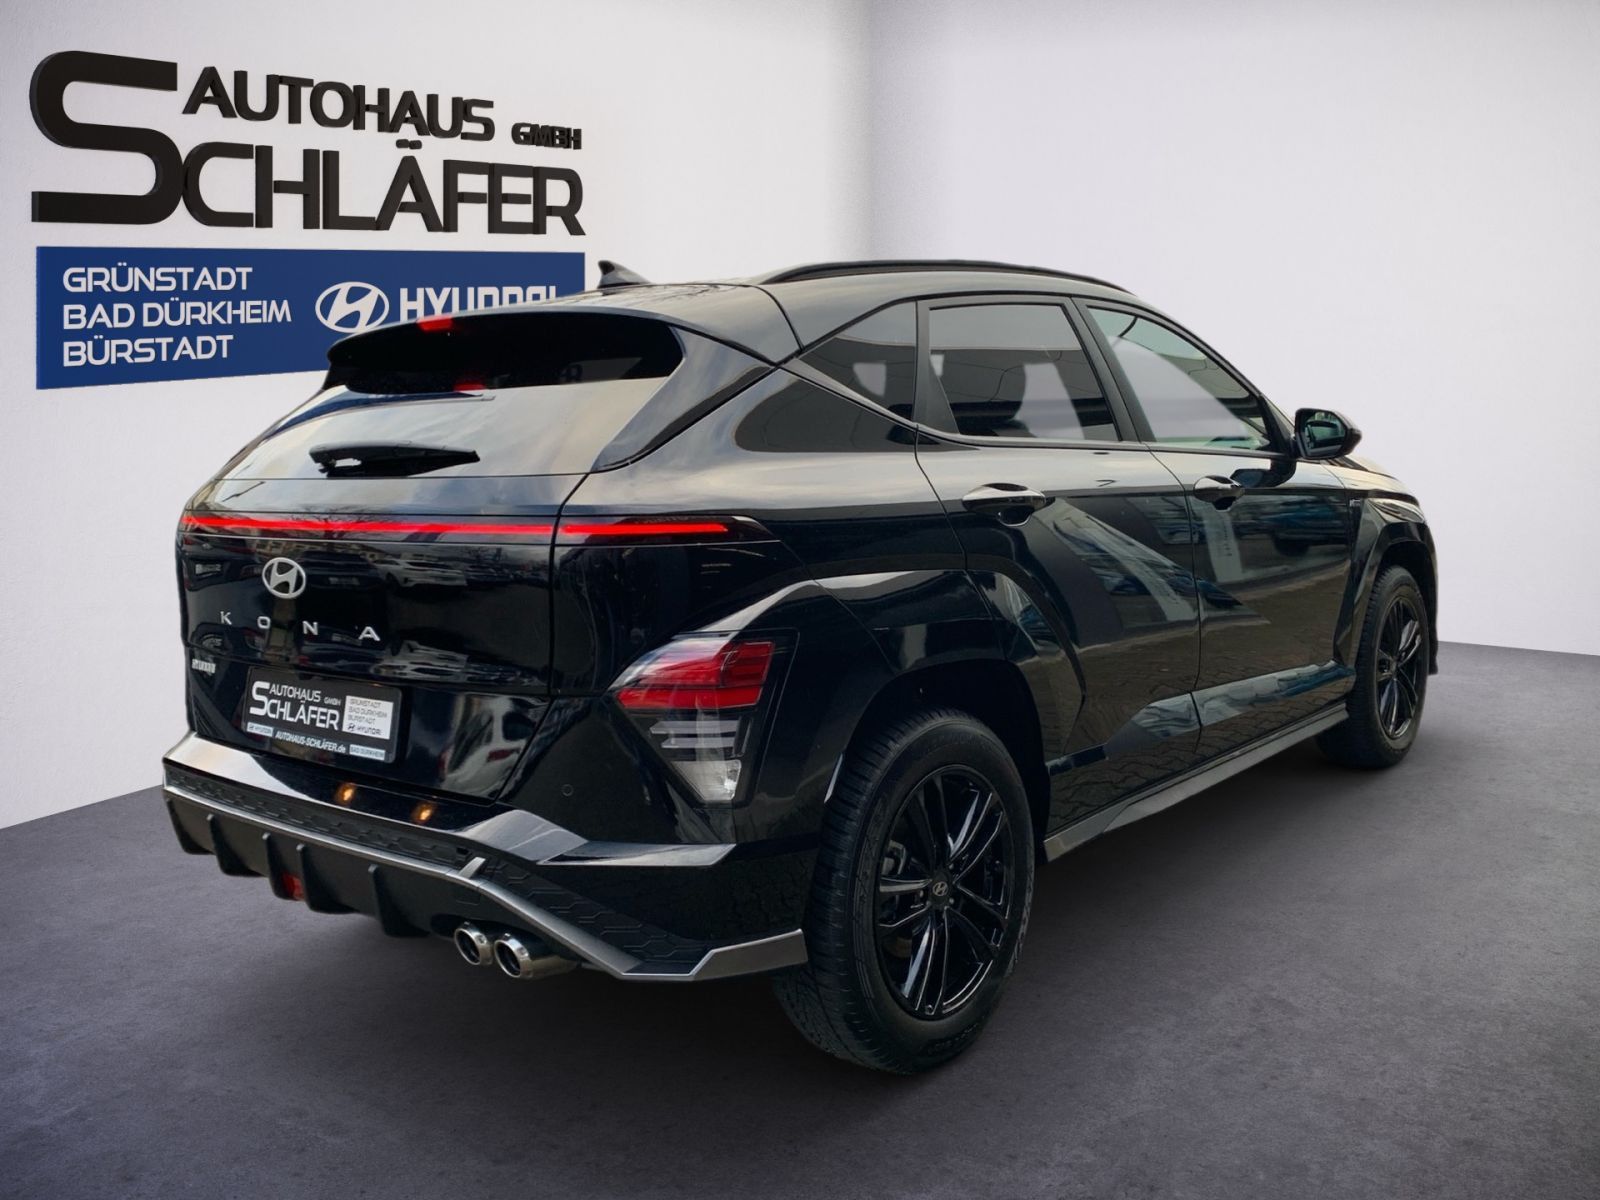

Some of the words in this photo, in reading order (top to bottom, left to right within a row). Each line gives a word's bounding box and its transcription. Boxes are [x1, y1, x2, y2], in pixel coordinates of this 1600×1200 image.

[182, 66, 495, 141] AUTOHAUS
[511, 122, 582, 150] GMBH
[29, 50, 586, 236] SCHLÄFER
[63, 262, 253, 292] GRÜNSTADT
[63, 303, 135, 329] BAD
[143, 297, 292, 327] DÜRKHEIM
[63, 335, 234, 367] BÜRSTADT
[220, 611, 381, 642] KONA
[249, 680, 339, 731] SCHLÄFER
[269, 683, 321, 703] AUTOHAUS
